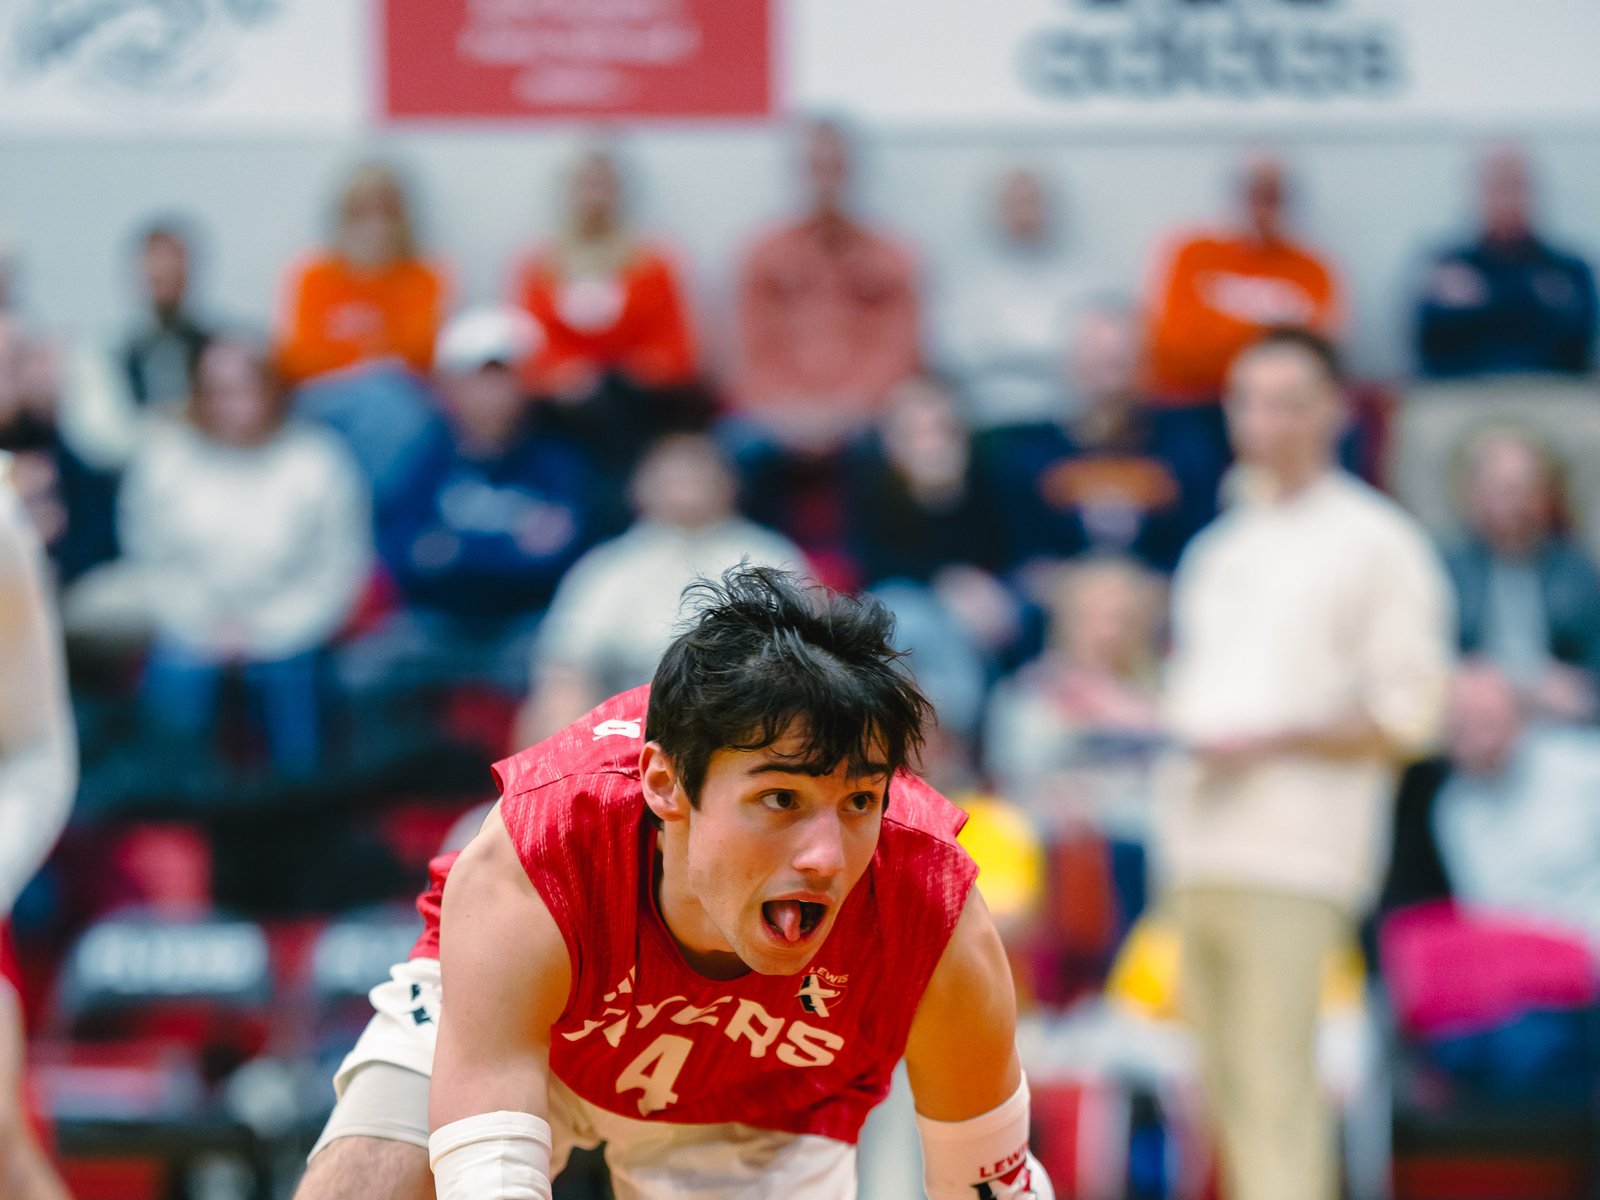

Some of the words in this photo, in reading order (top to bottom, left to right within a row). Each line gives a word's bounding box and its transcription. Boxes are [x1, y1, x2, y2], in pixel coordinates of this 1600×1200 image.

[809, 966, 849, 983] LEWIS
[615, 1033, 694, 1117] 4
[980, 1142, 1027, 1178] LEW
